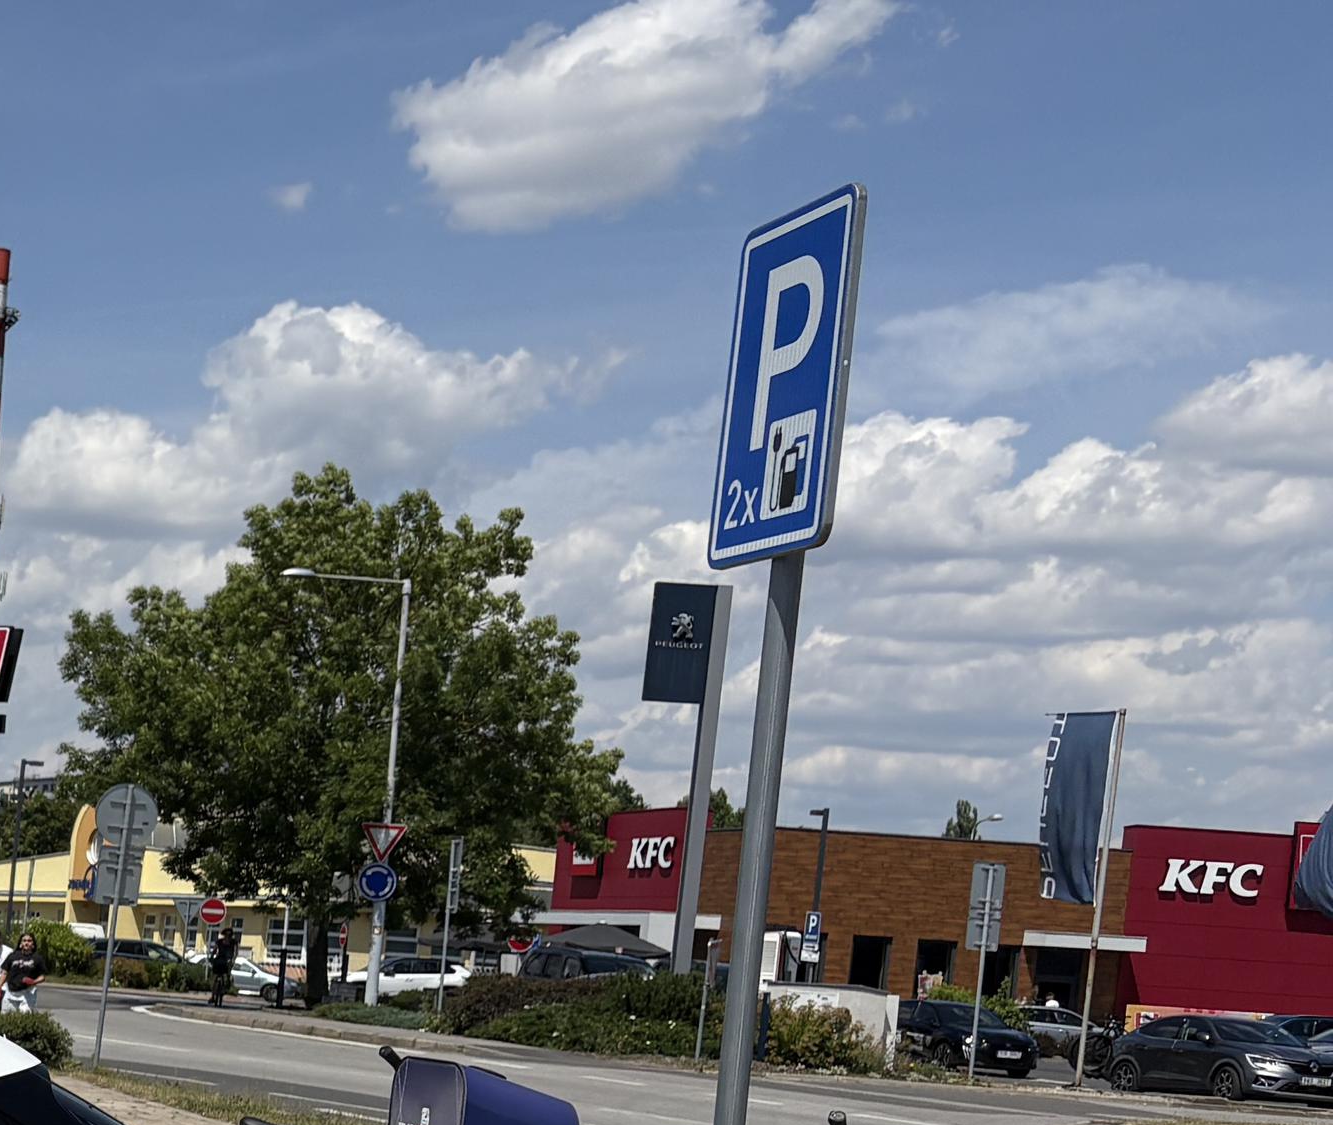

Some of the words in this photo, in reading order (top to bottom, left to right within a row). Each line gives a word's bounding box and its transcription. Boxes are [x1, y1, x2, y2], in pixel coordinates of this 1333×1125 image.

[749, 254, 825, 452] P
[723, 479, 759, 531] 2x
[654, 640, 704, 649] PEUGEOT
[627, 836, 675, 869] KFC
[1158, 858, 1264, 898] KFC
[808, 915, 818, 933] P
